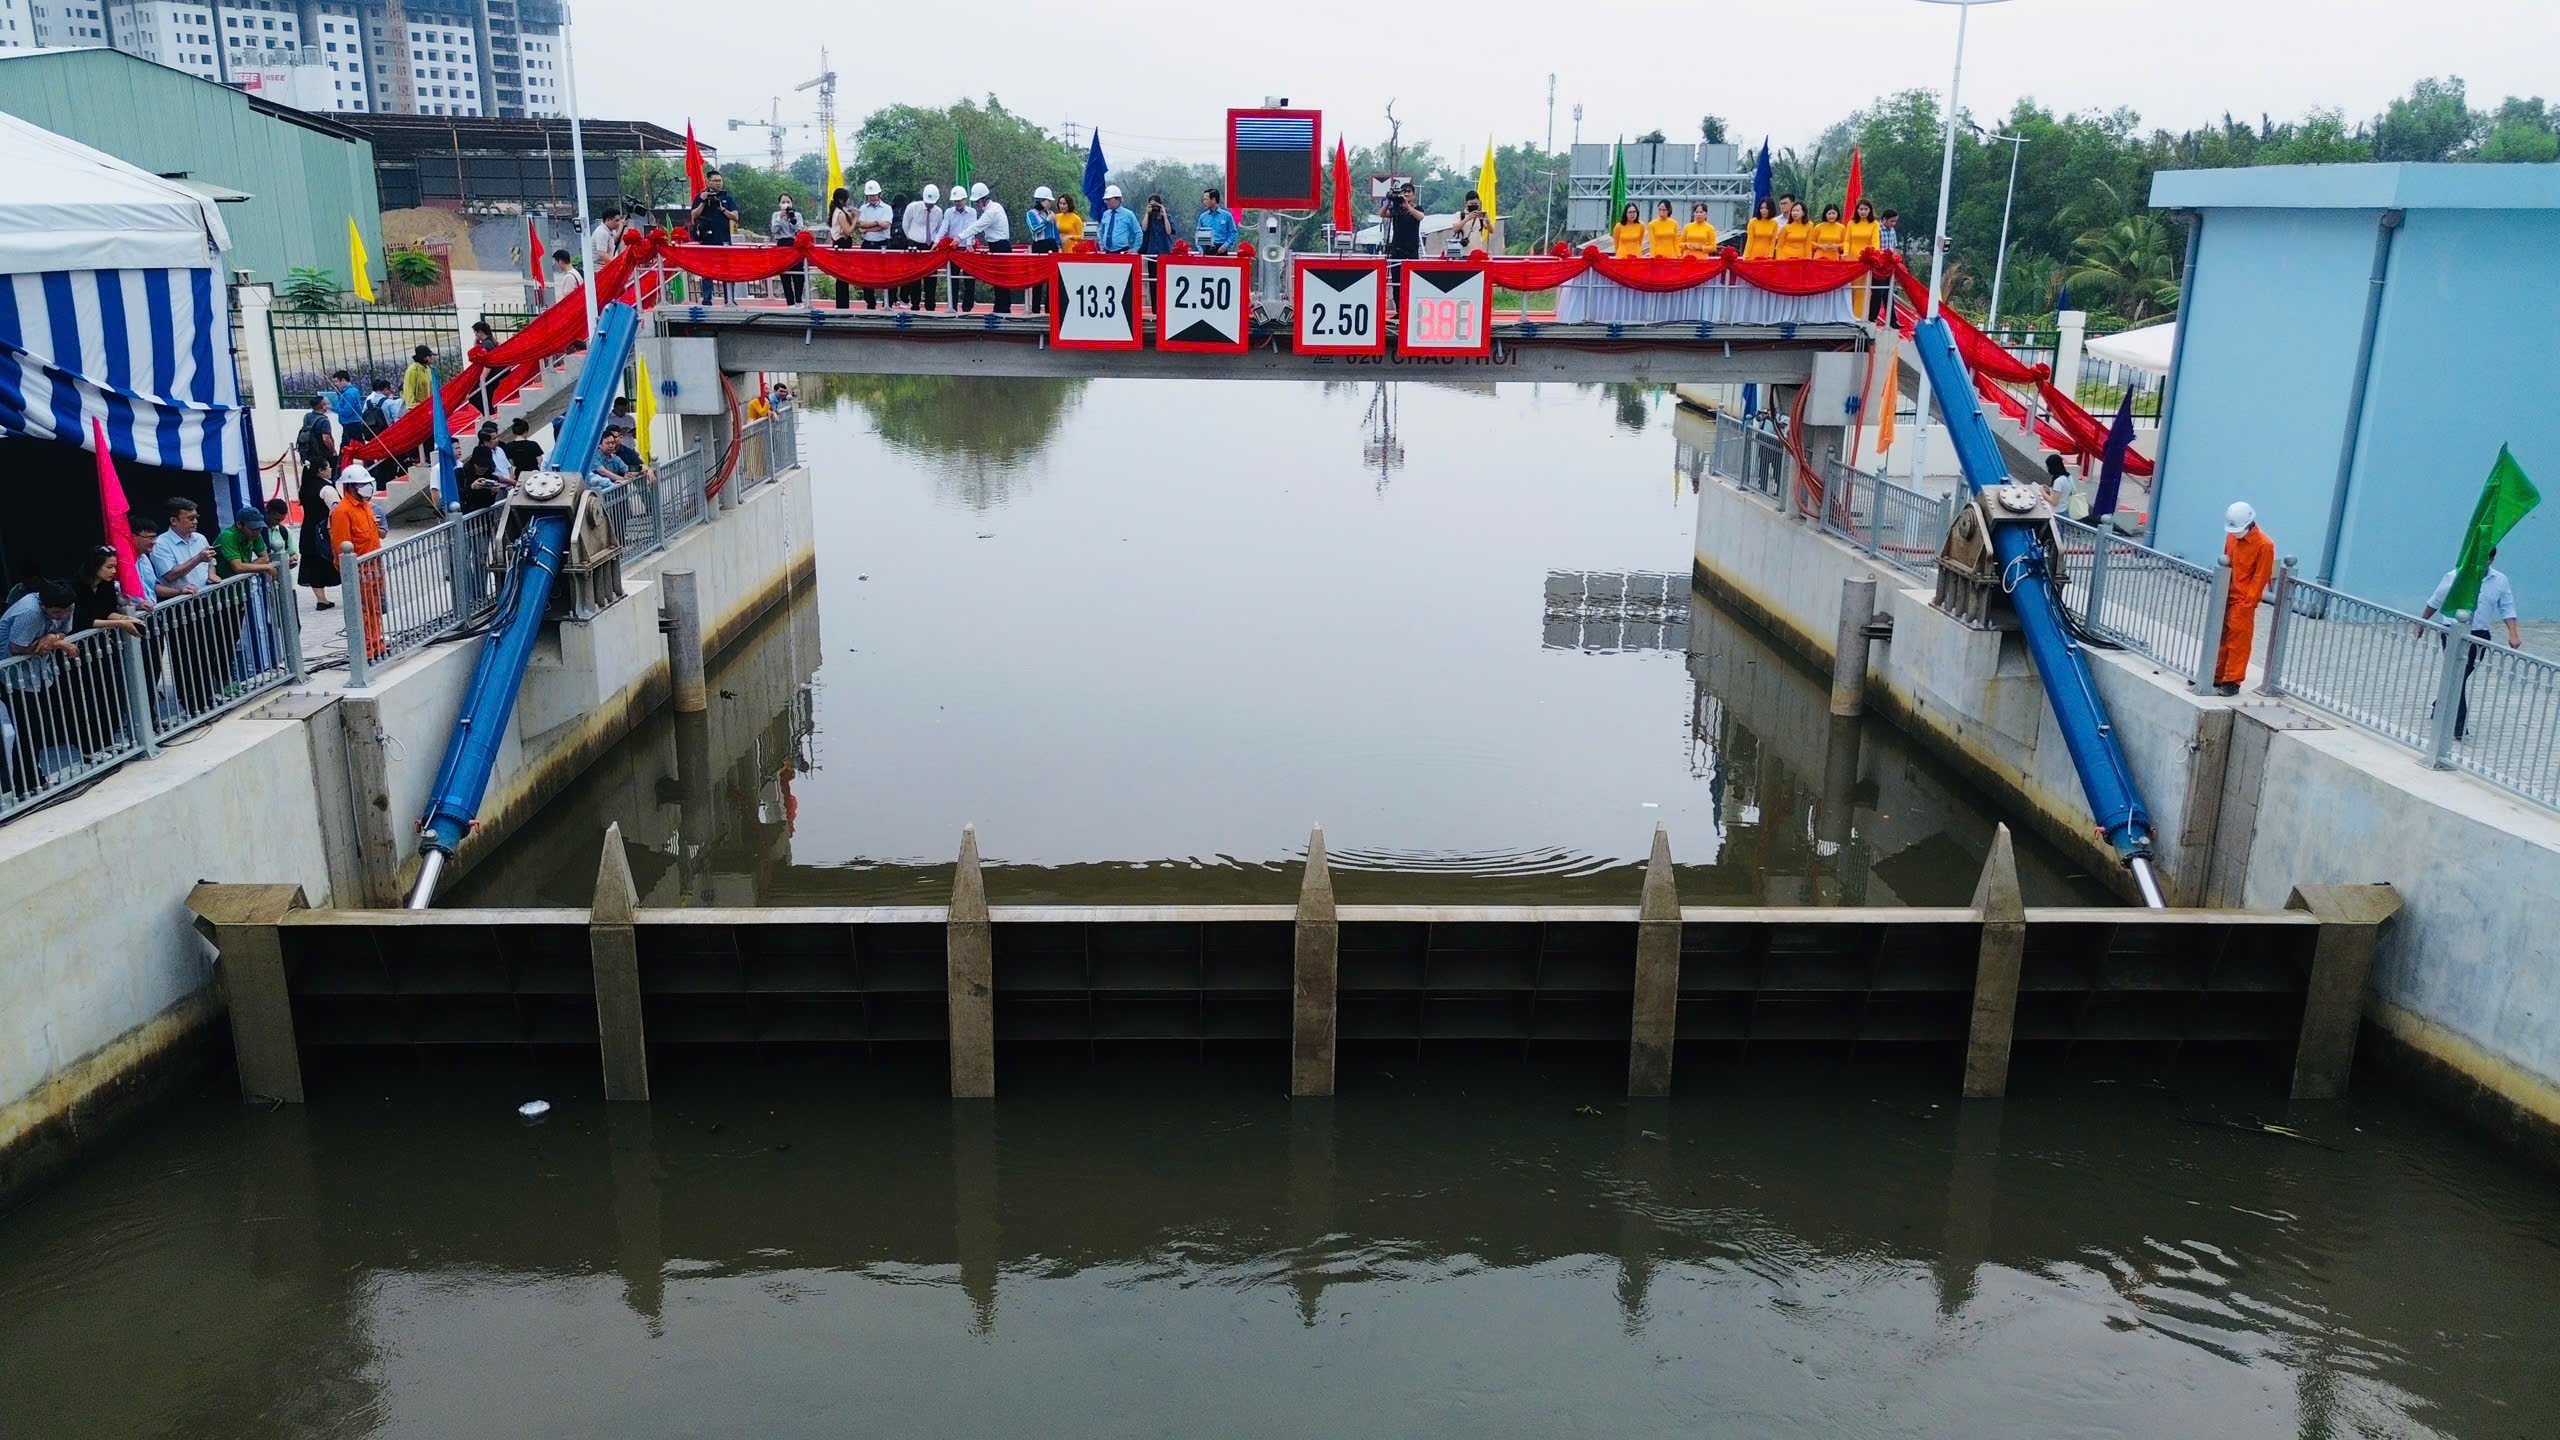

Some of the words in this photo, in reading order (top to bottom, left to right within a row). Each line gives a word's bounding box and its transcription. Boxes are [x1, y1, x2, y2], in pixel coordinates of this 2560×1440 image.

[1076, 285, 1116, 318] 13.3
[1174, 276, 1231, 311] 2.50
[1312, 303, 1369, 336] 2.50
